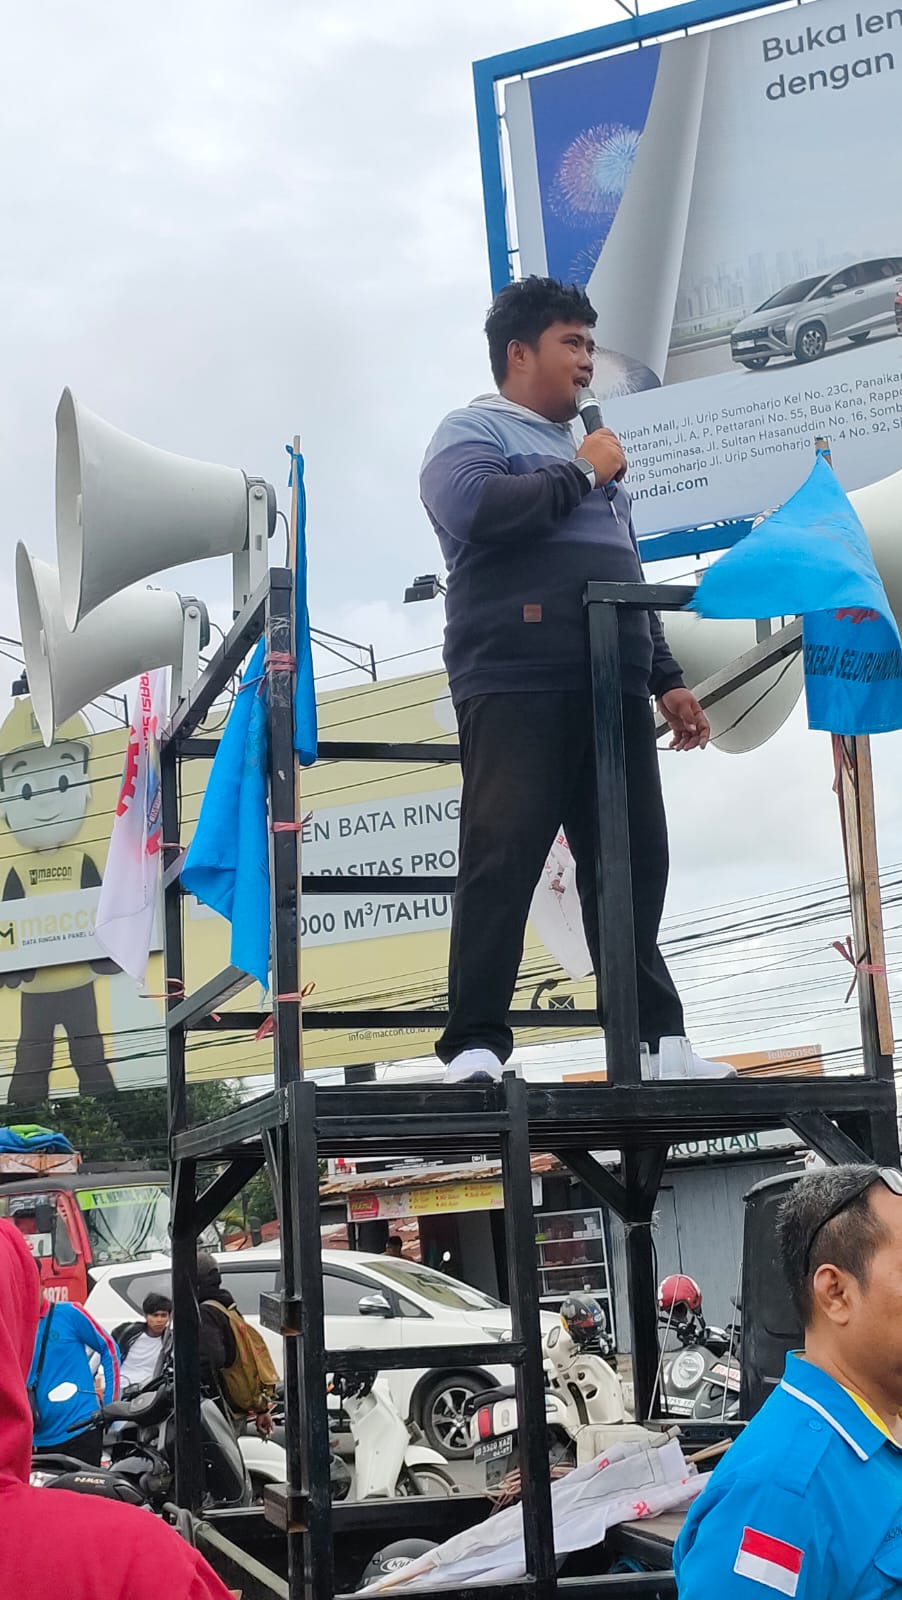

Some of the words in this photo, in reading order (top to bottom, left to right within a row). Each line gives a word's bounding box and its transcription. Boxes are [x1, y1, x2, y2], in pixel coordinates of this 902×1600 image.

[762, 24, 846, 62] Buka
[855, 9, 902, 38] len
[766, 52, 895, 101] dengan
[618, 425, 650, 441] Nipah
[652, 420, 679, 434] Mall,
[681, 416, 694, 428] Jl.
[696, 411, 719, 424] Urip
[721, 398, 781, 418] Sumoharjo
[784, 393, 801, 406] Kel
[804, 390, 824, 401] No.
[827, 383, 853, 397] 23C,
[855, 372, 902, 390] Panaika
[674, 433, 687, 444] Jl.
[689, 430, 700, 441] A.
[703, 427, 713, 438] P.
[716, 416, 765, 435] Pettarani
[768, 412, 788, 423] No.
[790, 408, 807, 420] 55,
[810, 404, 832, 416] Bua
[835, 397, 866, 410] Kana,
[623, 472, 646, 485] Urip
[648, 459, 707, 480] Sumoharjo
[709, 455, 722, 466] Jl.
[725, 450, 748, 463] Urip
[750, 438, 811, 458] Sumoharjo
[839, 430, 846, 440] 4
[849, 427, 869, 438] No.
[872, 421, 890, 433] 92,
[627, 446, 704, 469] ungguminasa,
[706, 442, 719, 452] Jl.
[721, 434, 756, 449] Sultan
[759, 421, 826, 440] Hasanuddin
[829, 415, 849, 427] No.
[851, 410, 867, 422] 16,
[629, 475, 709, 501] undai.com
[140, 672, 152, 713] RASI
[339, 811, 396, 838] BATA
[38, 866, 72, 879] maccon
